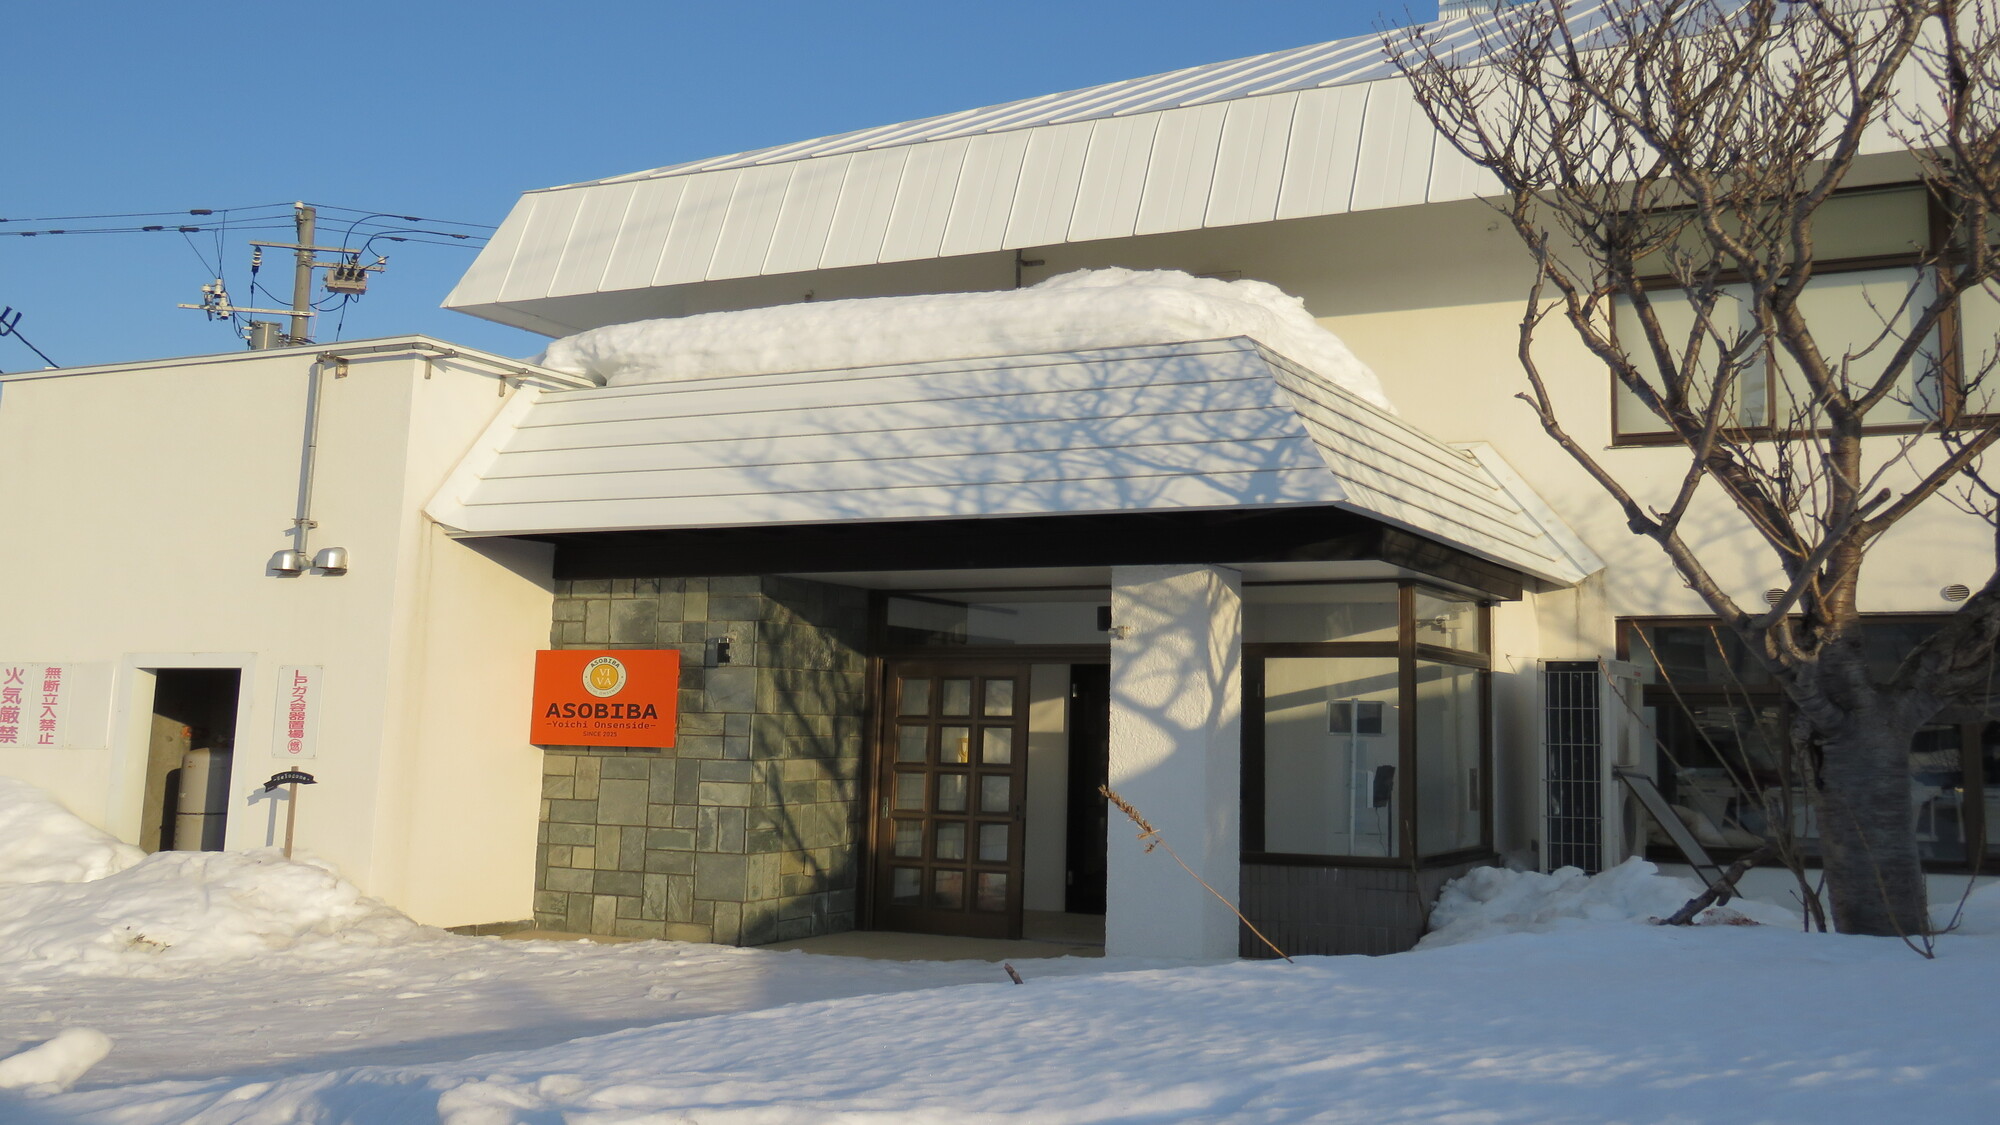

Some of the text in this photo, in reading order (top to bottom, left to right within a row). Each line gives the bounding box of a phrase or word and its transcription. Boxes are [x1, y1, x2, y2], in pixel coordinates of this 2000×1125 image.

[590, 658, 620, 668] ASOBIBA
[0, 667, 25, 744] 火気厳禁
[37, 667, 62, 745] 無断立入禁止
[545, 702, 658, 720] ASOBIBA
